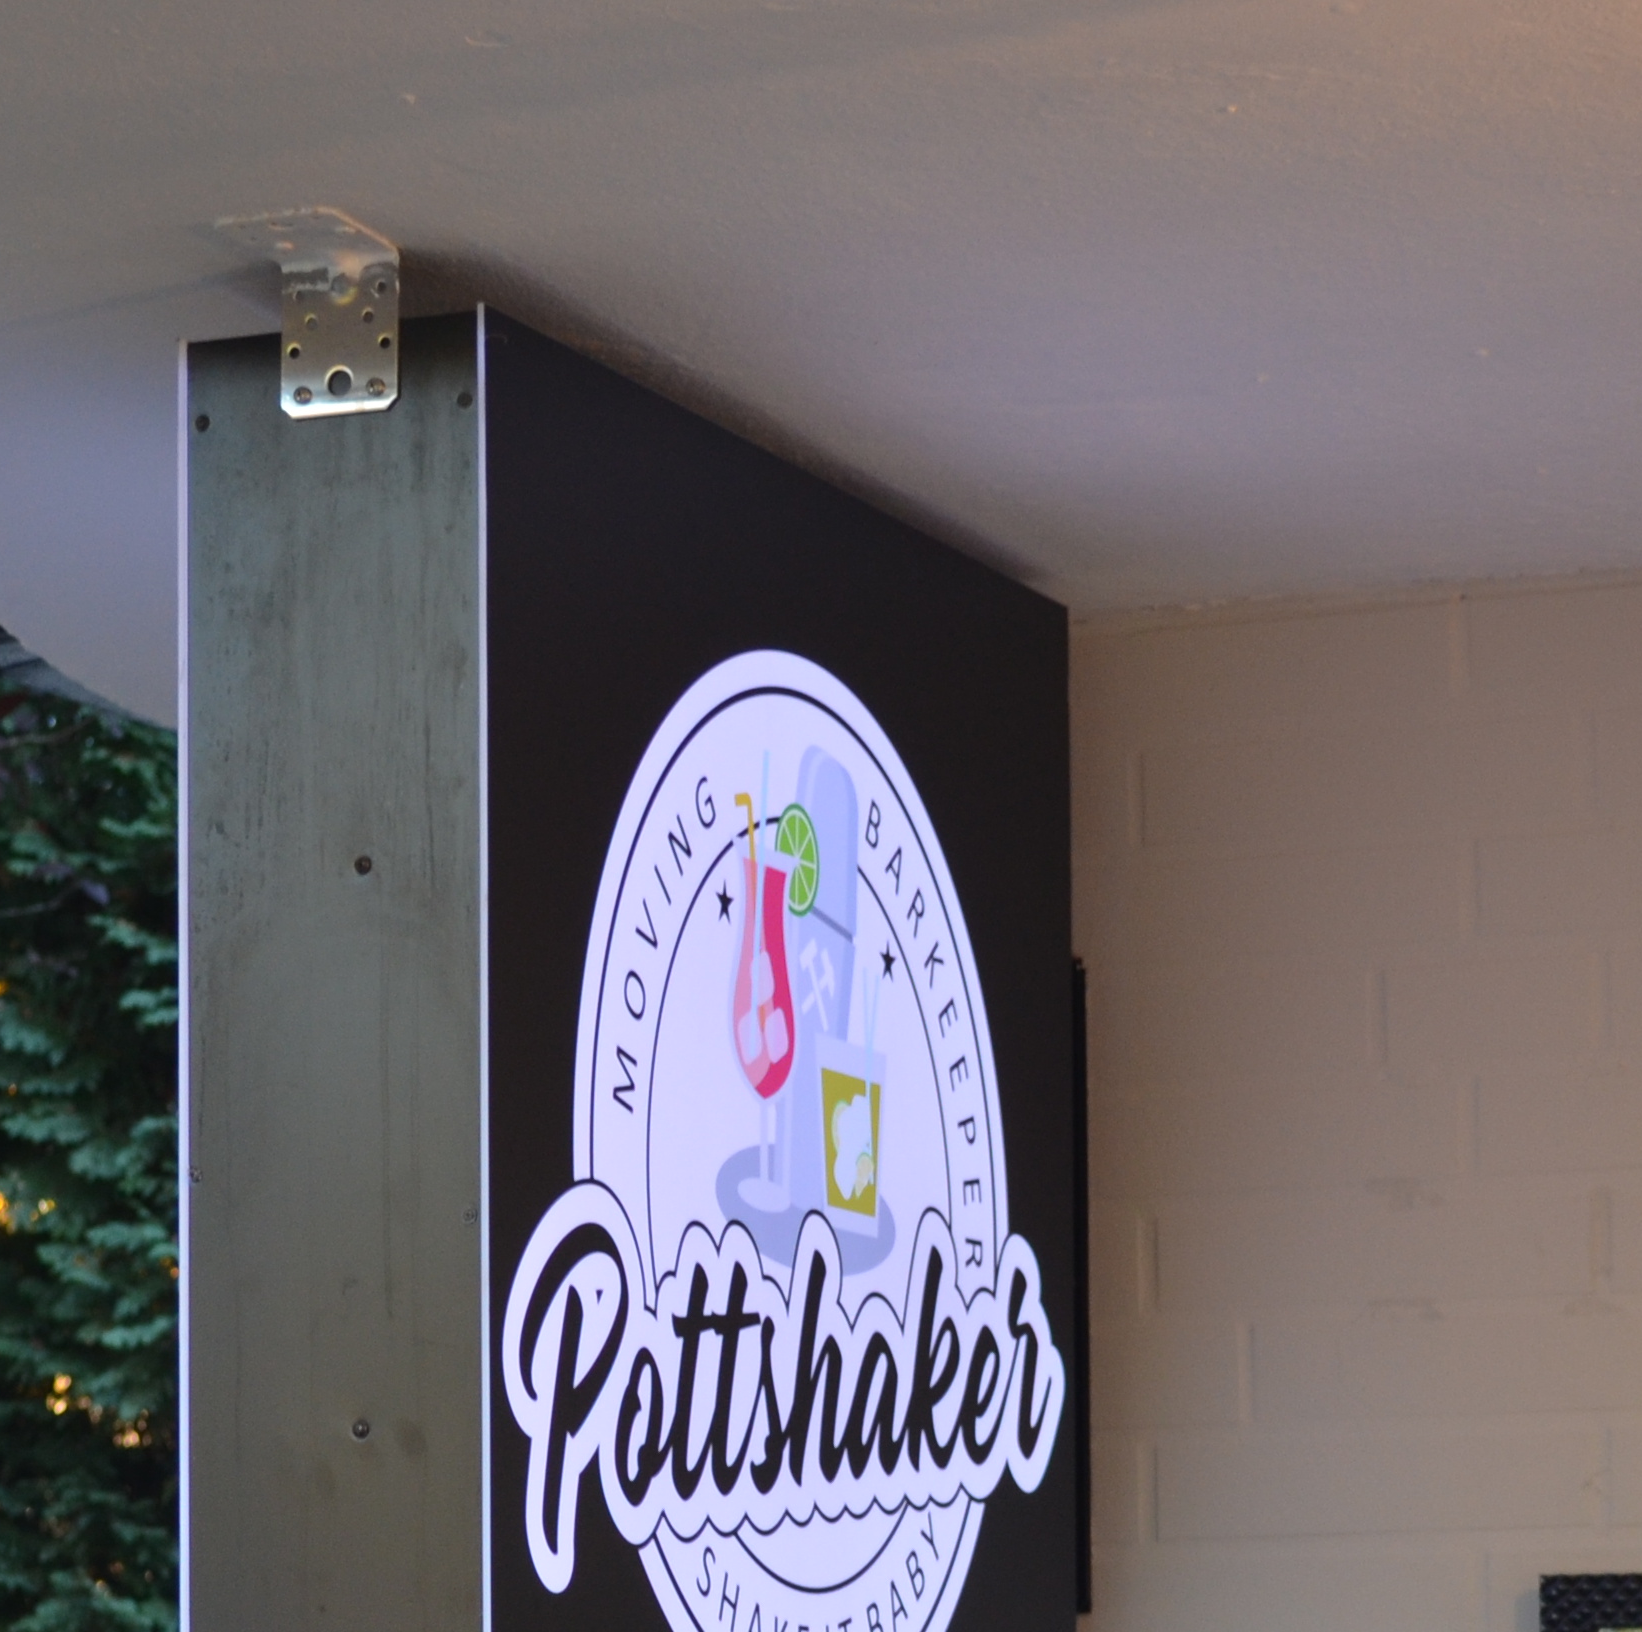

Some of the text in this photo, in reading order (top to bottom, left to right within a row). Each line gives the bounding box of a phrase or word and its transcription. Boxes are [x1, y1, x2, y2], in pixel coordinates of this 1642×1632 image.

[612, 776, 717, 1114] MOVING
[864, 799, 985, 1270] BARKEEPER
[518, 1221, 1053, 1556] Pottshaker
